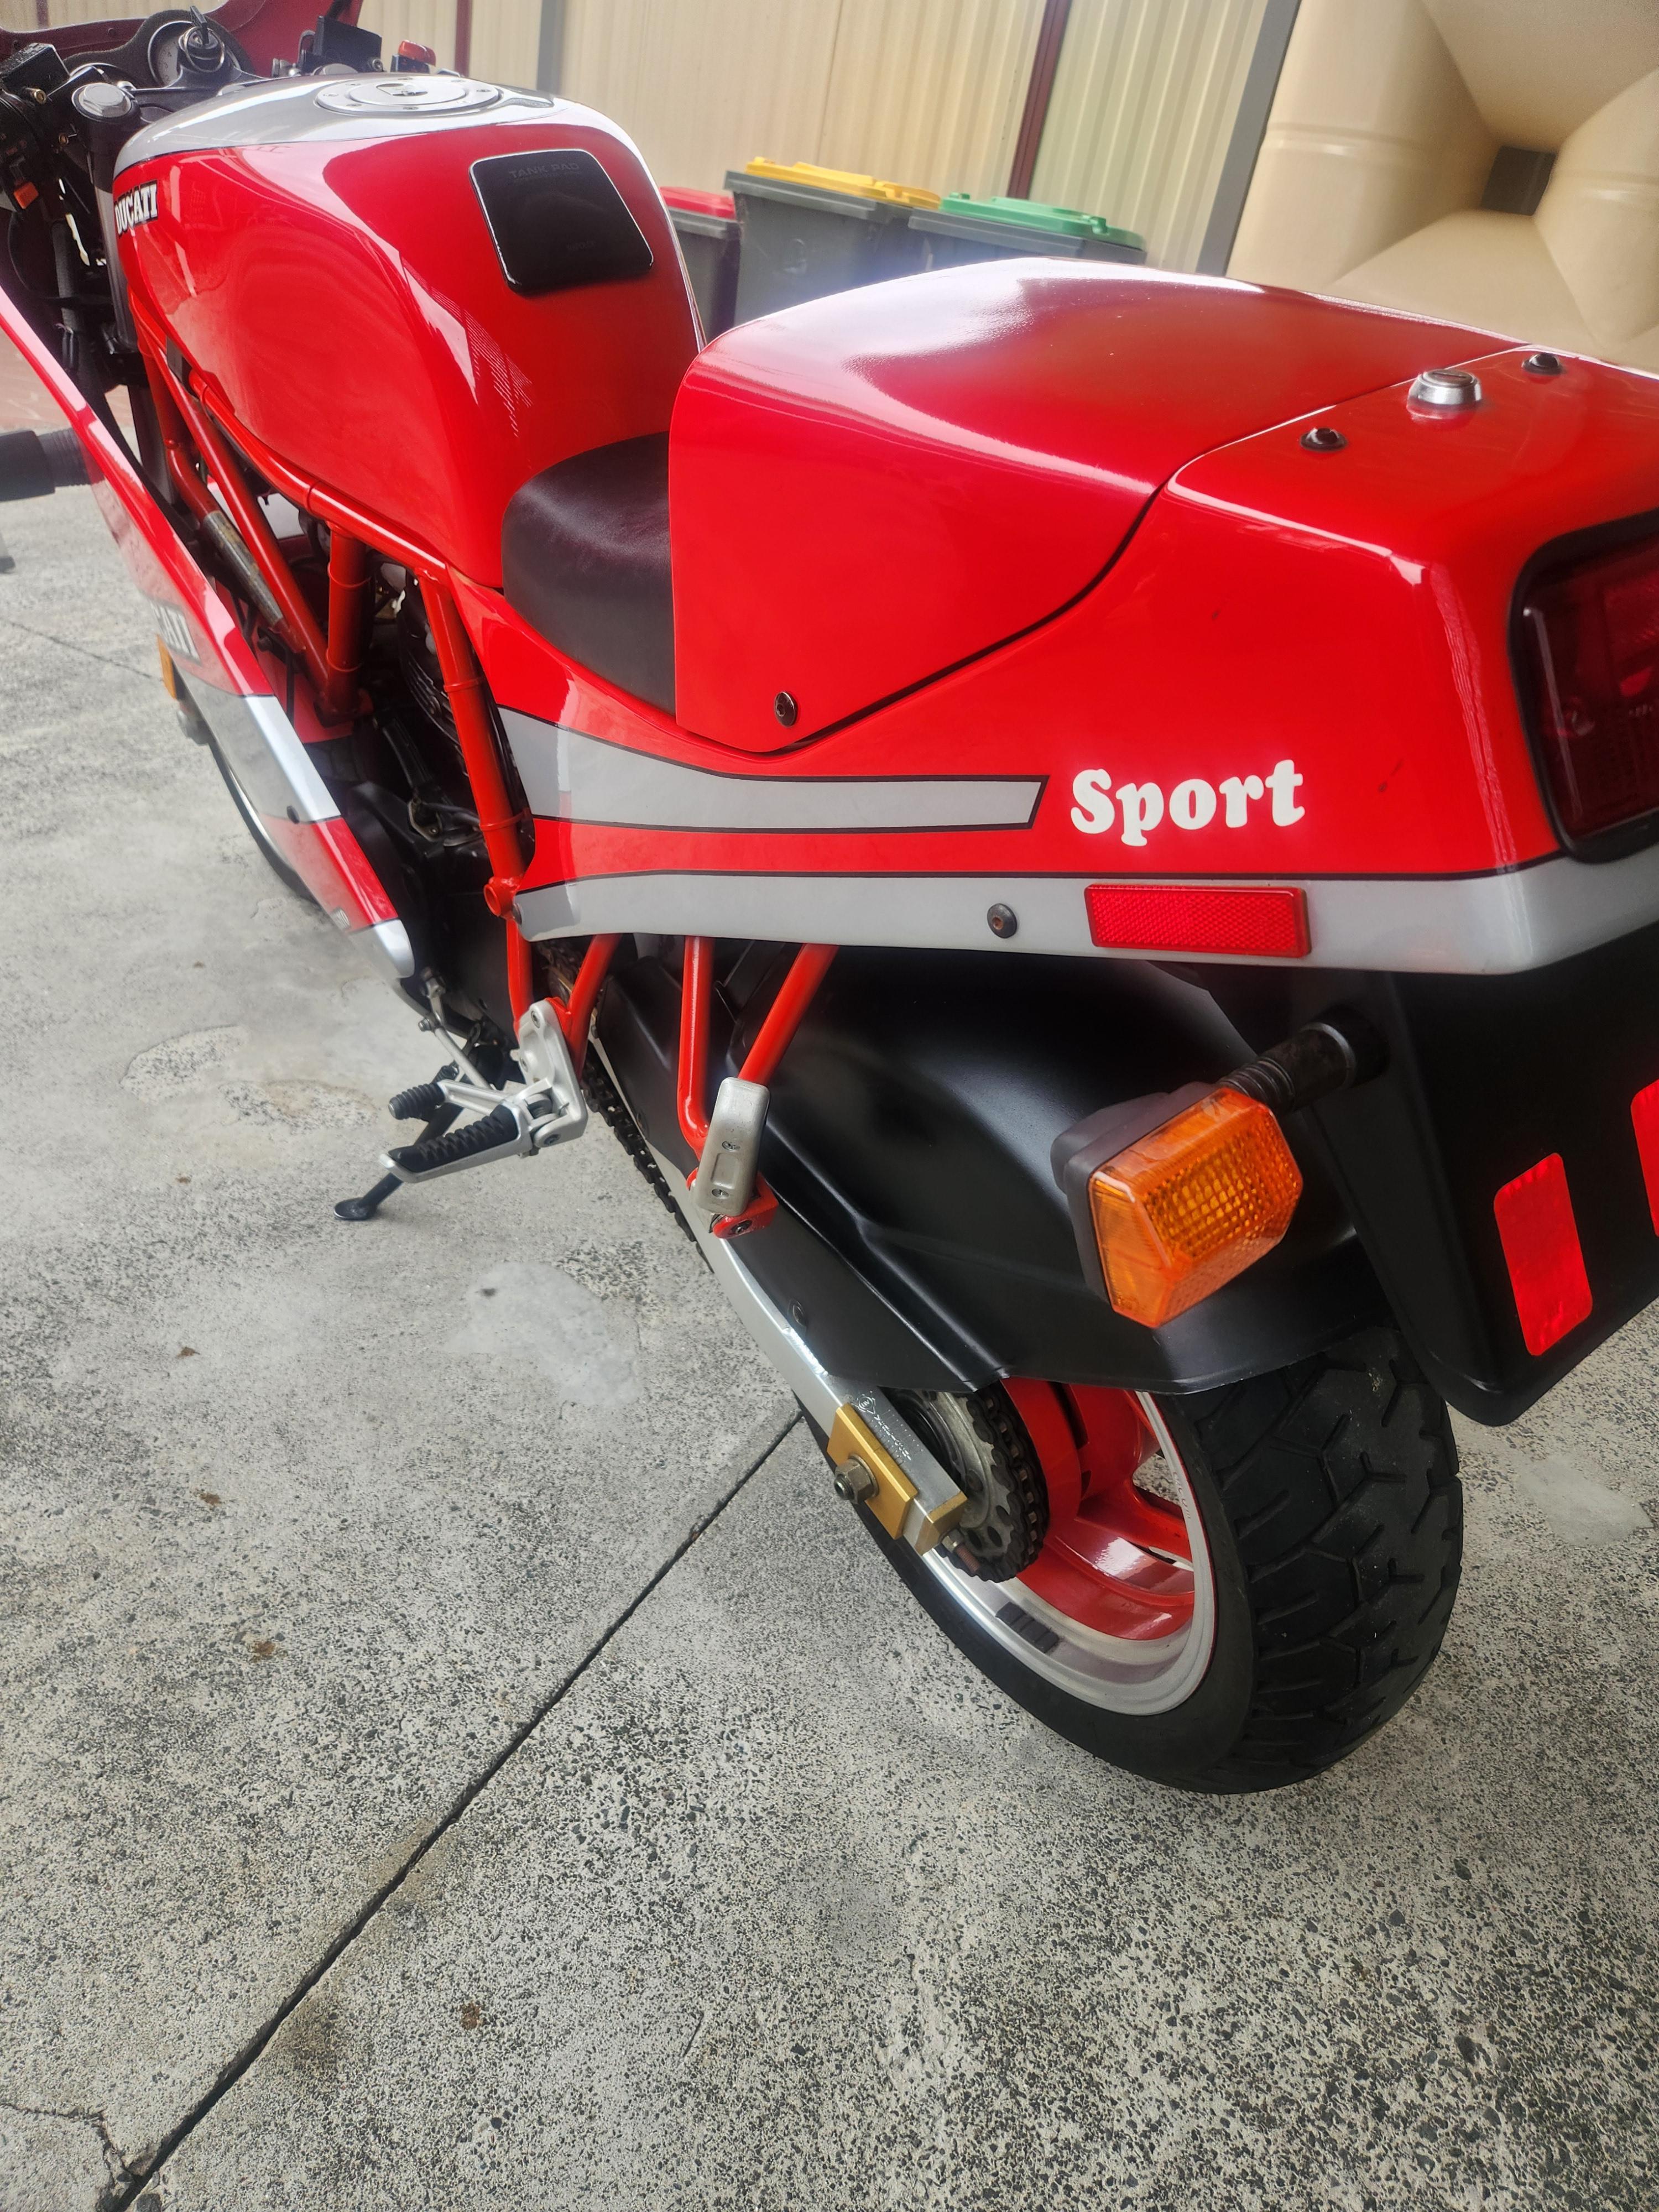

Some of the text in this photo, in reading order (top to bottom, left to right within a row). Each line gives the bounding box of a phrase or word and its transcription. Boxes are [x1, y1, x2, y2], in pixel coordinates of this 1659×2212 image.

[508, 165, 549, 178] TANK
[551, 162, 580, 171] PAD
[114, 183, 158, 236] DUCATI
[1071, 759, 1306, 847] Sport
